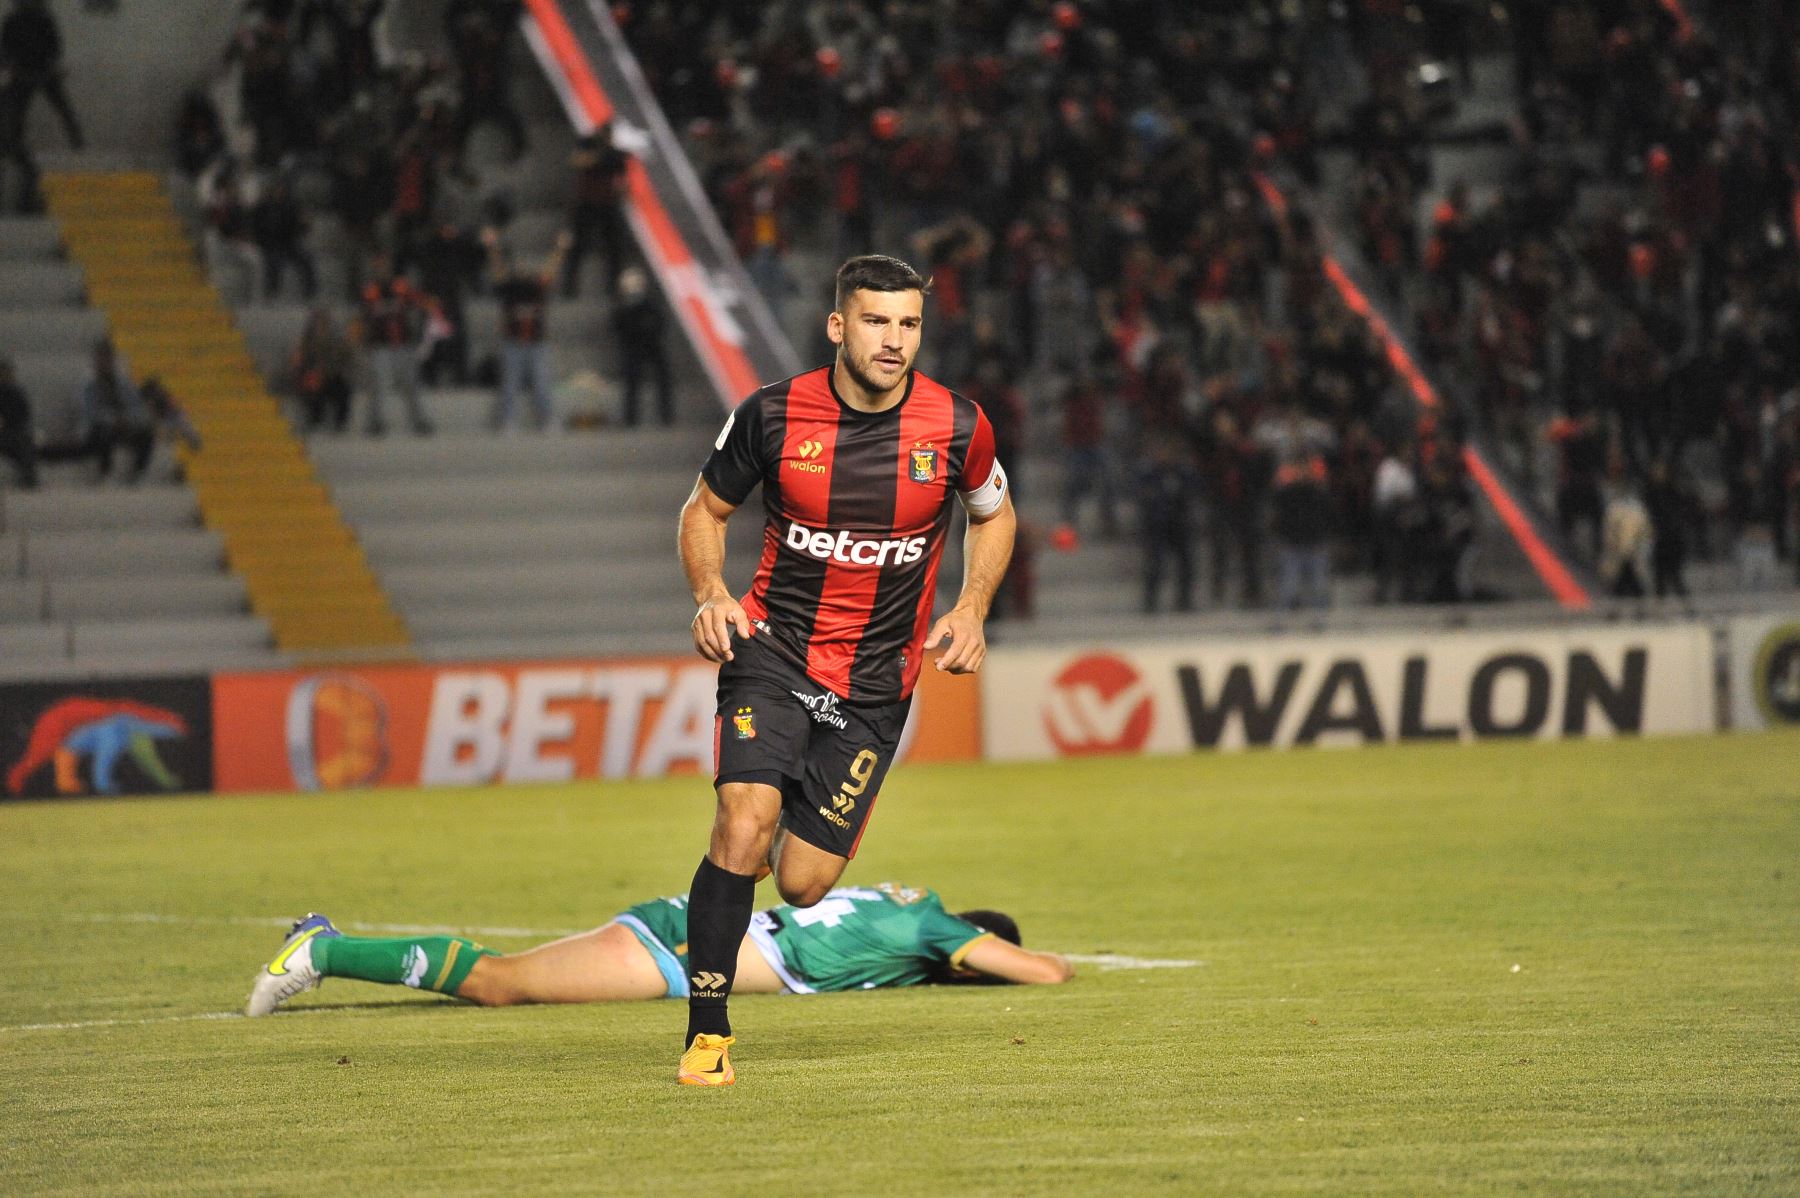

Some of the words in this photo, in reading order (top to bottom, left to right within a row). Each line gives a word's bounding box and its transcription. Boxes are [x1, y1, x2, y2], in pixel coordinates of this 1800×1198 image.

[790, 460, 826, 474] walon
[786, 523, 926, 565] betcris
[1176, 648, 1649, 752] WALON
[841, 749, 877, 796] 9
[819, 805, 850, 830] walon
